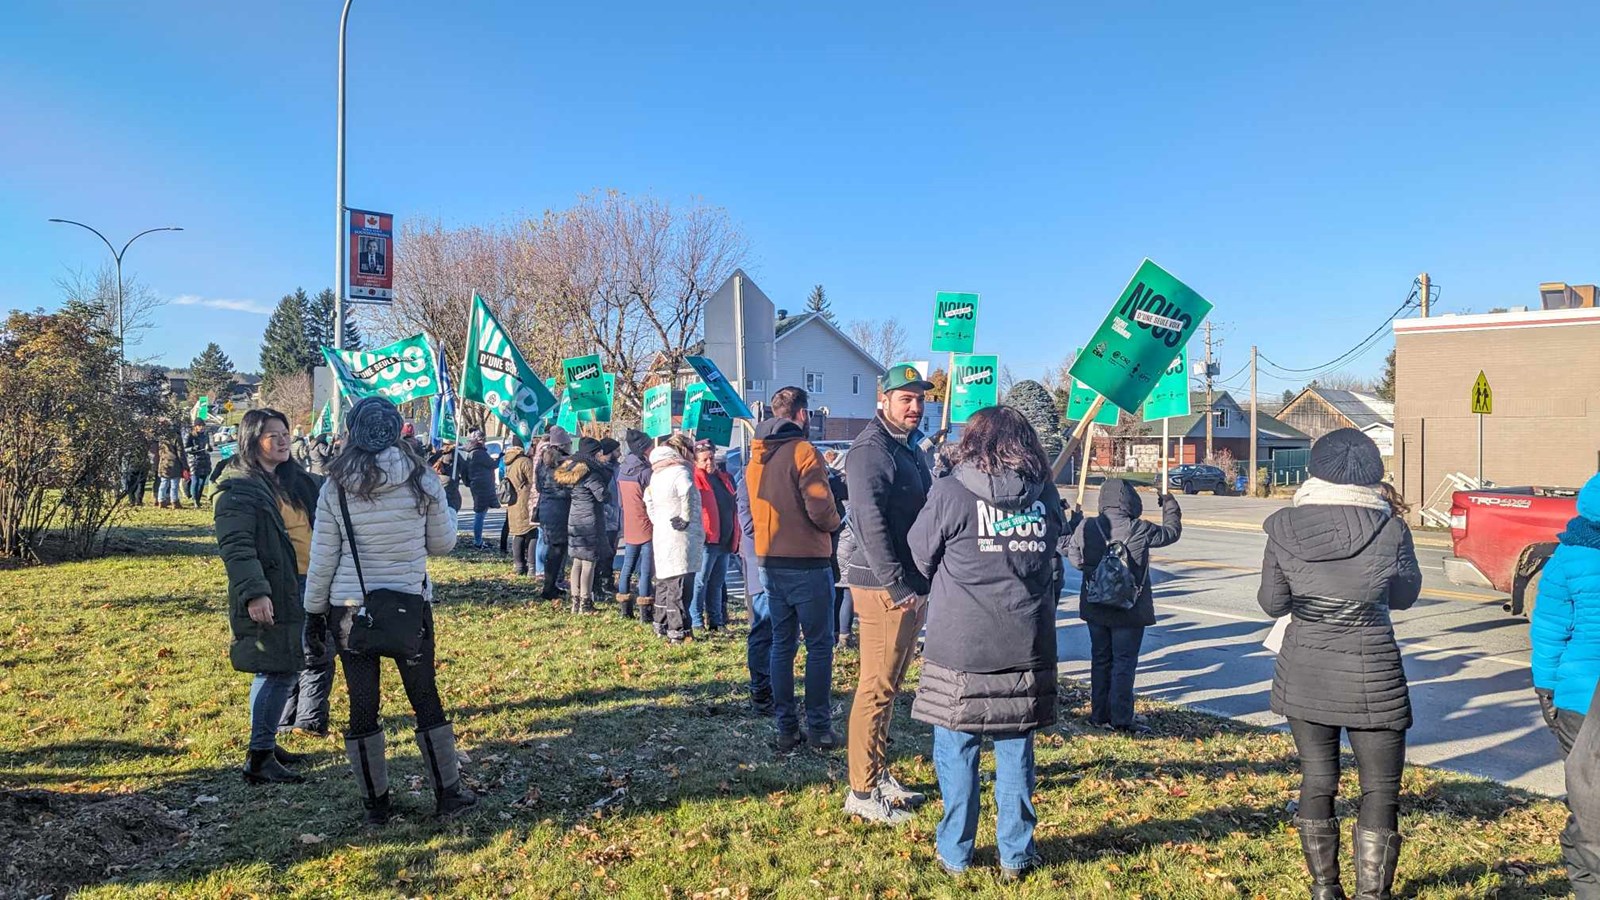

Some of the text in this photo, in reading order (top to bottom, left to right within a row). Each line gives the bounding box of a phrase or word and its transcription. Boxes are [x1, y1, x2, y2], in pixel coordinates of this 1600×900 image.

[938, 301, 975, 320] NOUS
[1119, 282, 1192, 348] NOUS
[1153, 316, 1168, 326] SEULE
[1168, 320, 1181, 330] VOIX
[374, 357, 395, 371] SEULE
[480, 354, 503, 370] D'UNE
[567, 362, 600, 382] NOUS
[956, 365, 994, 385] NOUS
